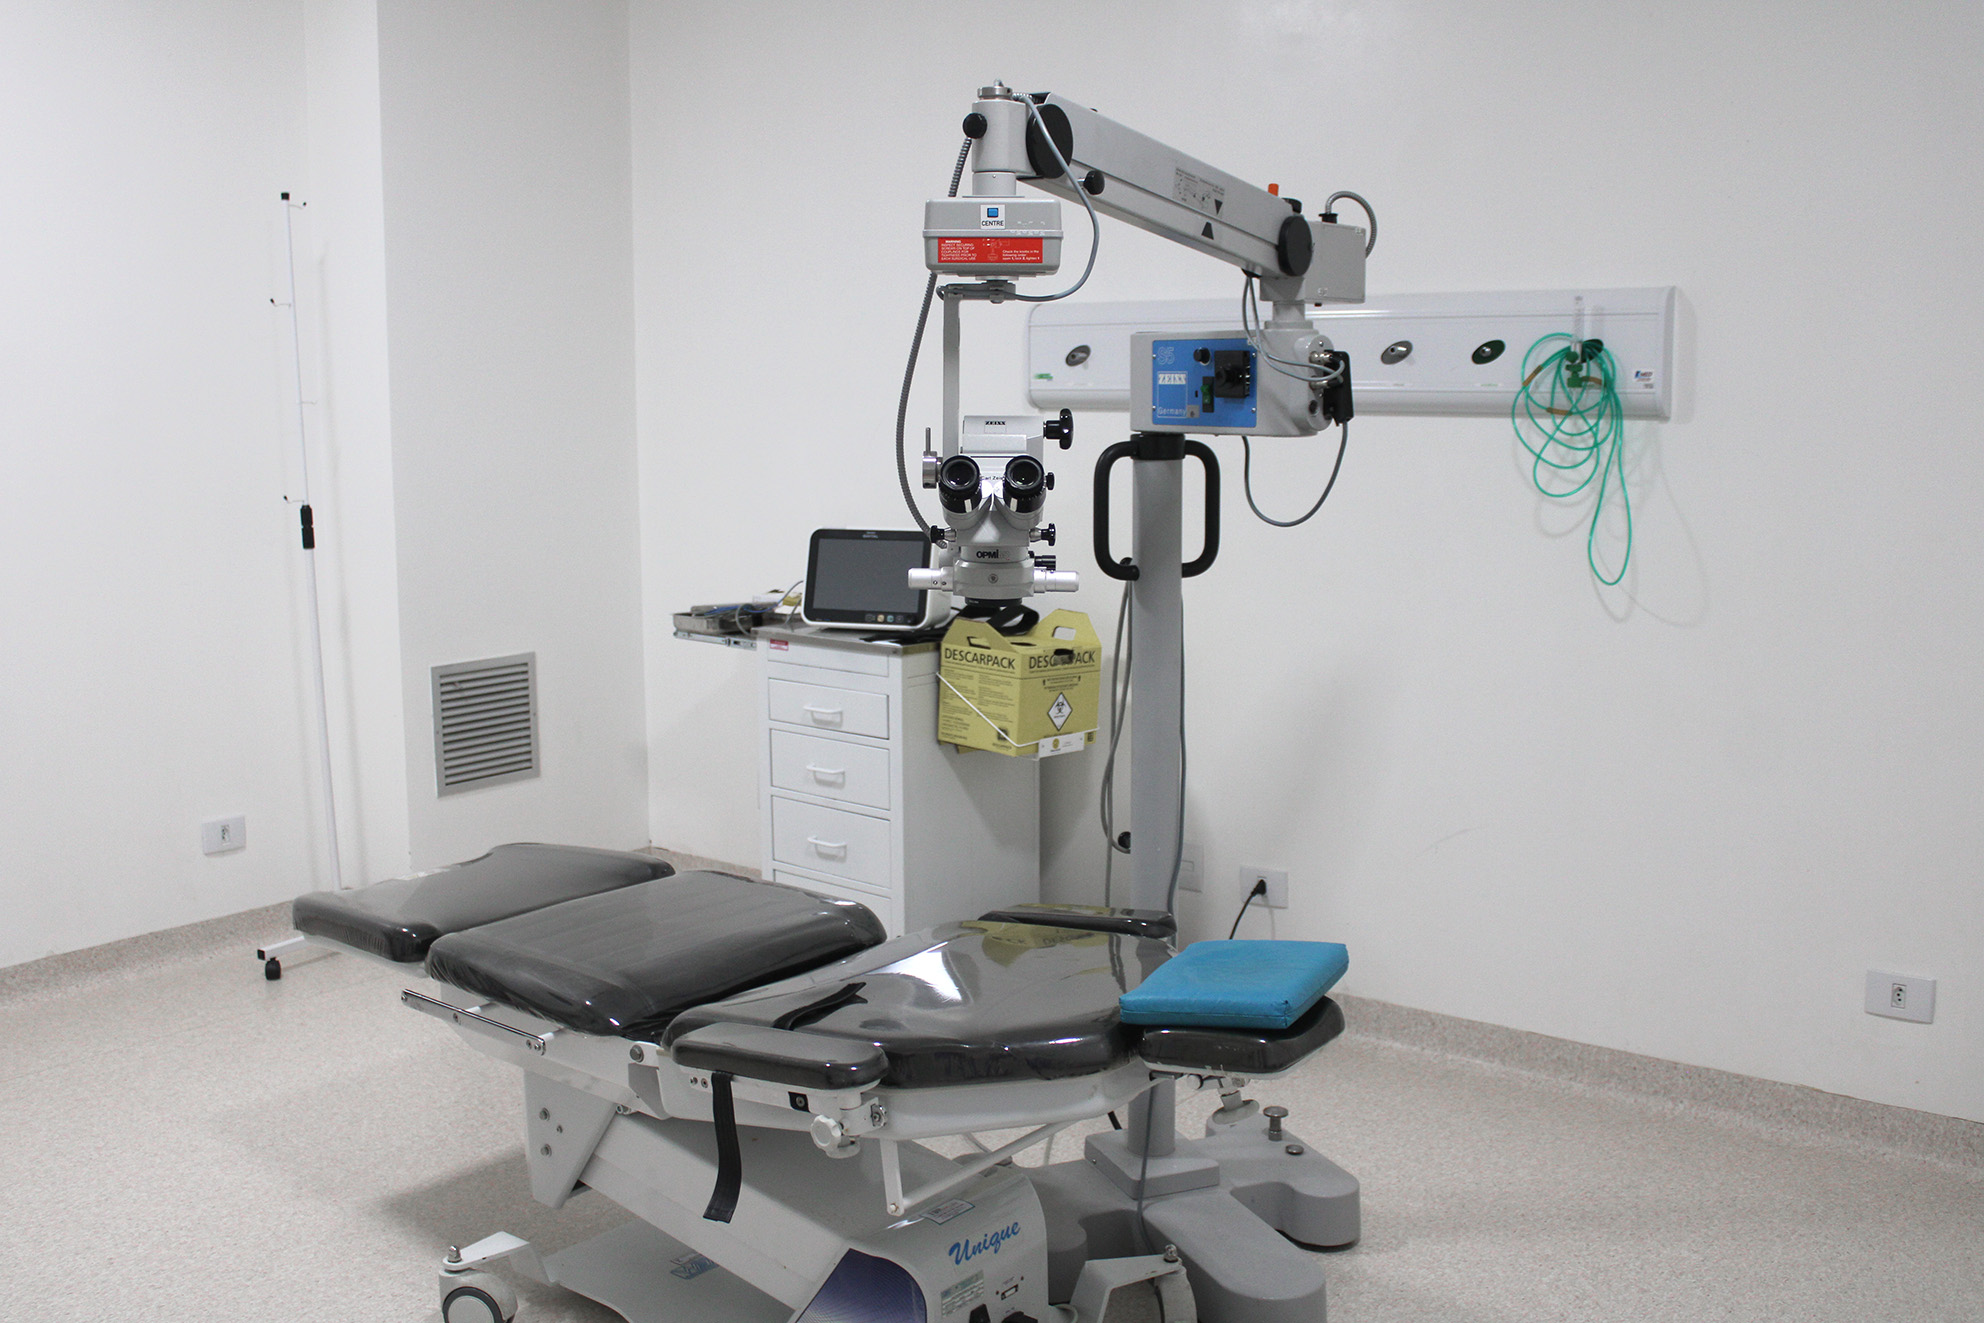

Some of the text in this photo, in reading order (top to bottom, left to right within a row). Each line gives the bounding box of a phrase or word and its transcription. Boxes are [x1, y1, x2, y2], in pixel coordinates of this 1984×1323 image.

[1158, 374, 1186, 385] ZEISS
[1158, 407, 1186, 416] Germany
[944, 647, 1016, 670] DESCARPACK
[1029, 651, 1096, 669] DESCACK
[948, 1222, 1021, 1265] Unique
